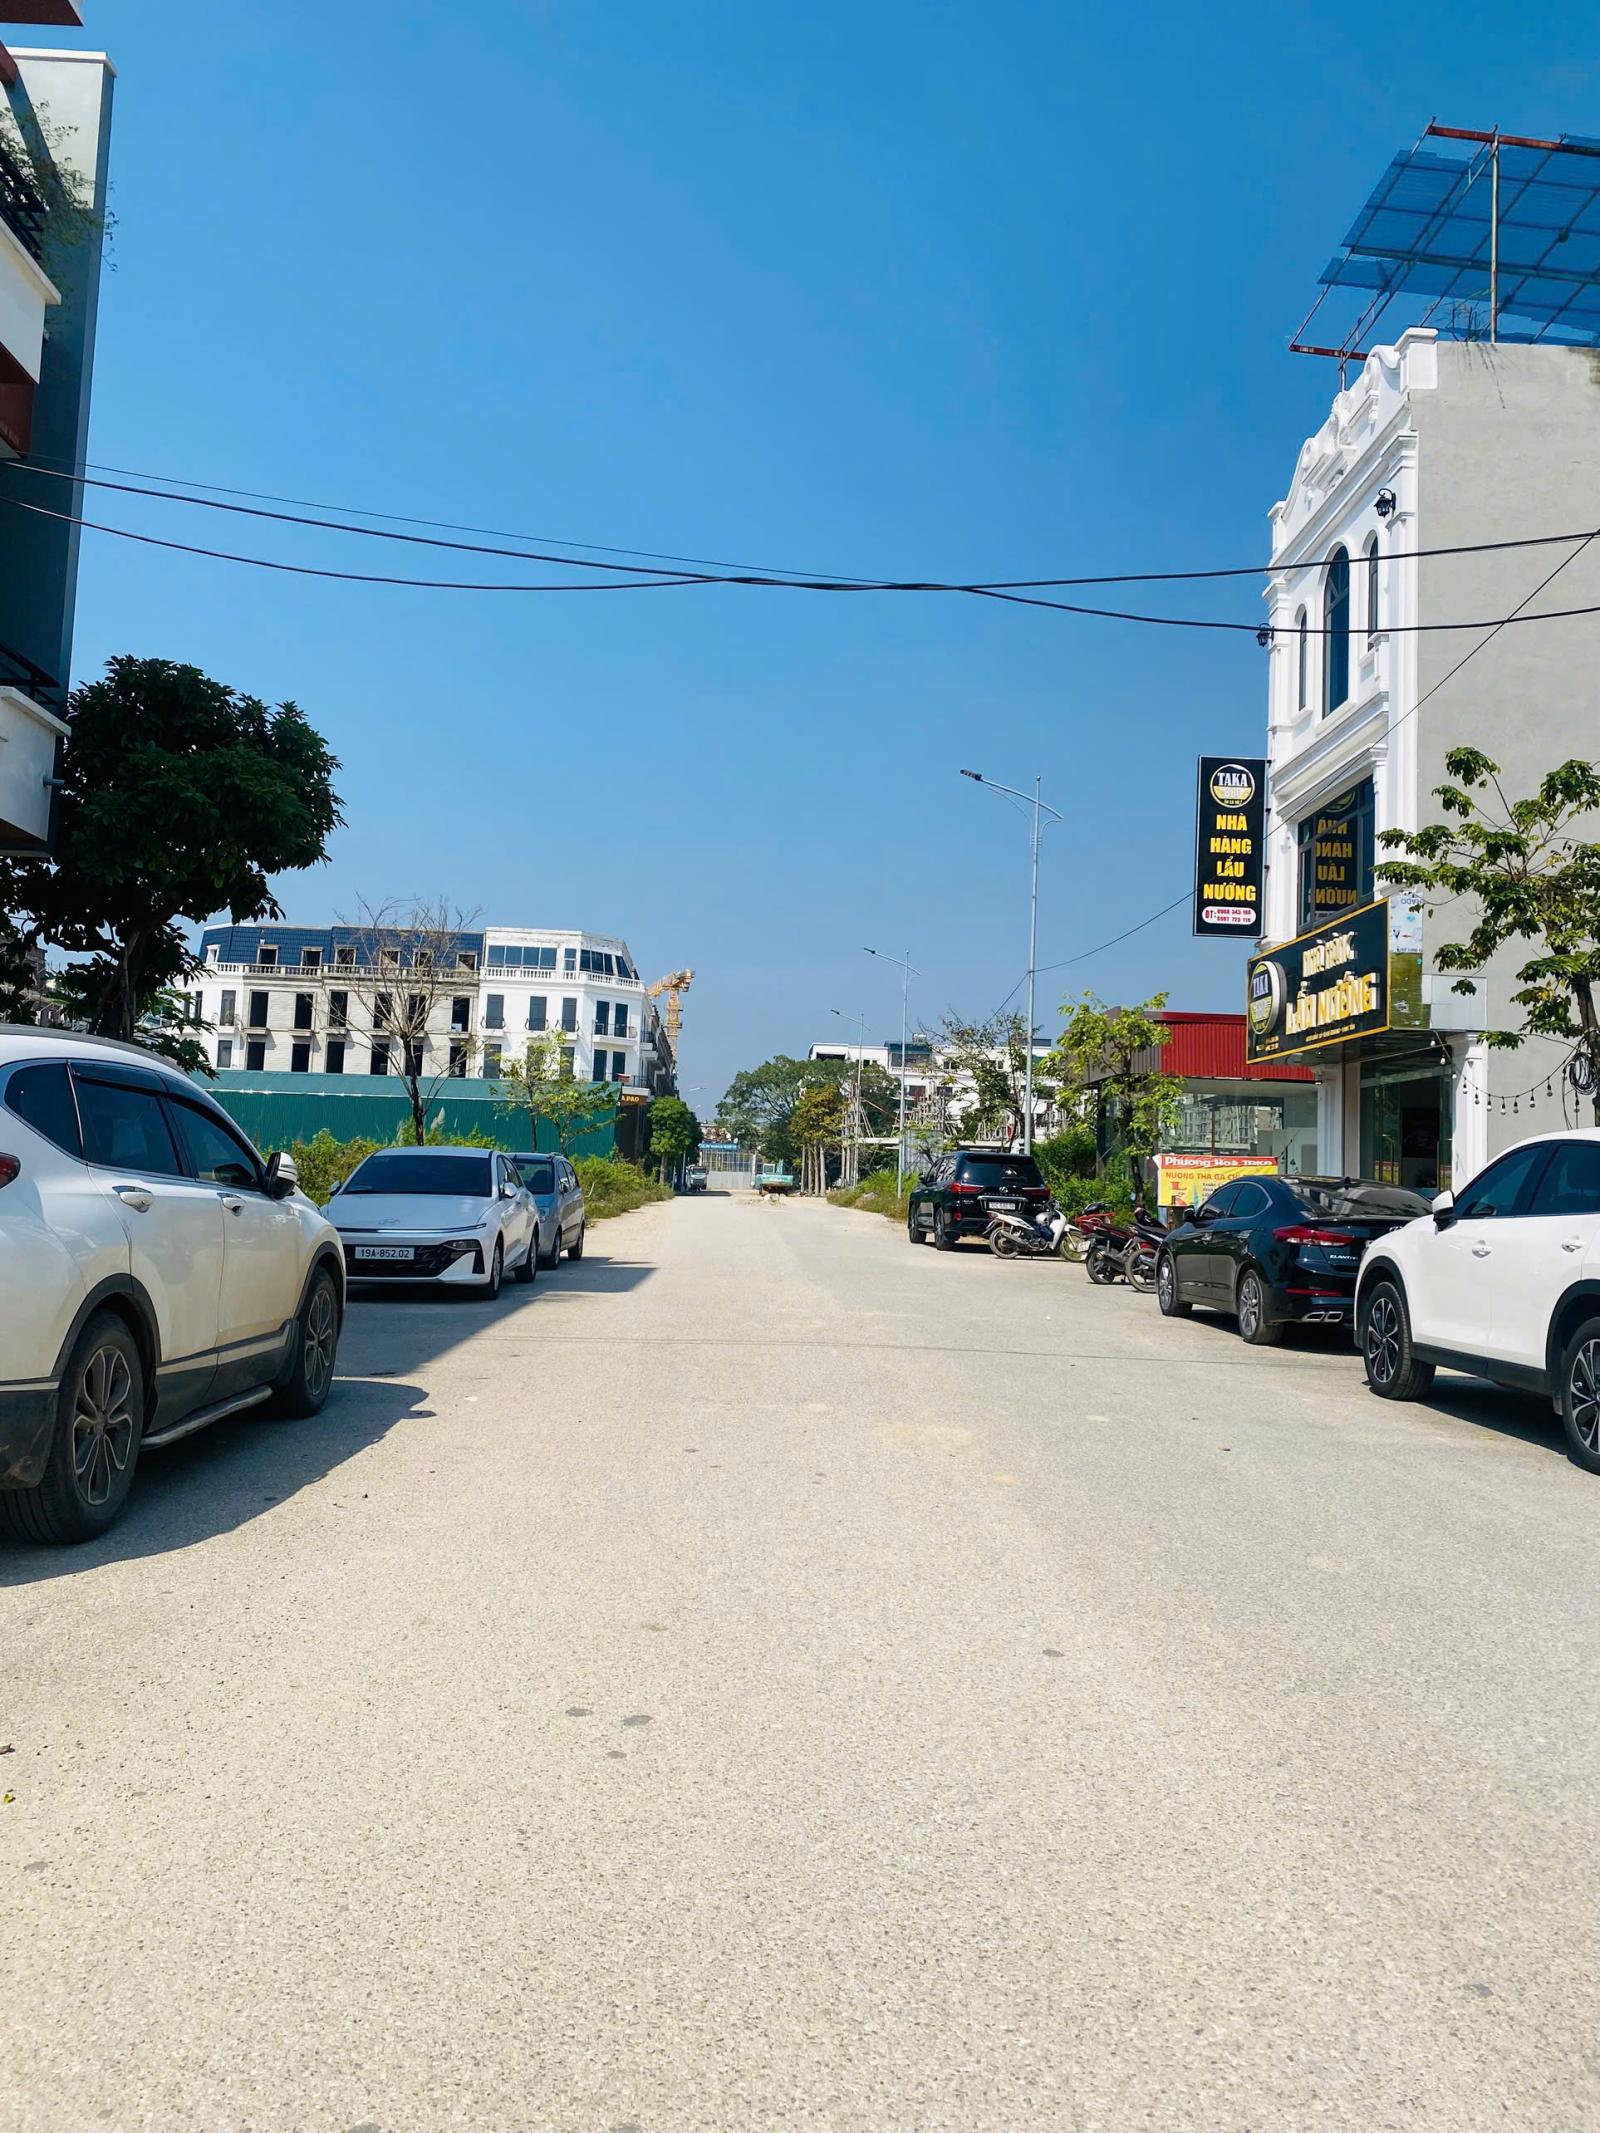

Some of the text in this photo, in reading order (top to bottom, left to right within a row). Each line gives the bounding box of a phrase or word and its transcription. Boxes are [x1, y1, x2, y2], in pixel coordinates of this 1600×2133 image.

[1217, 772, 1248, 787] TAKA
[1216, 813, 1248, 831] NHÀ
[1210, 836, 1252, 855] HÀNG
[1216, 856, 1245, 878] LẨU
[1203, 882, 1257, 902] NƯỚNG
